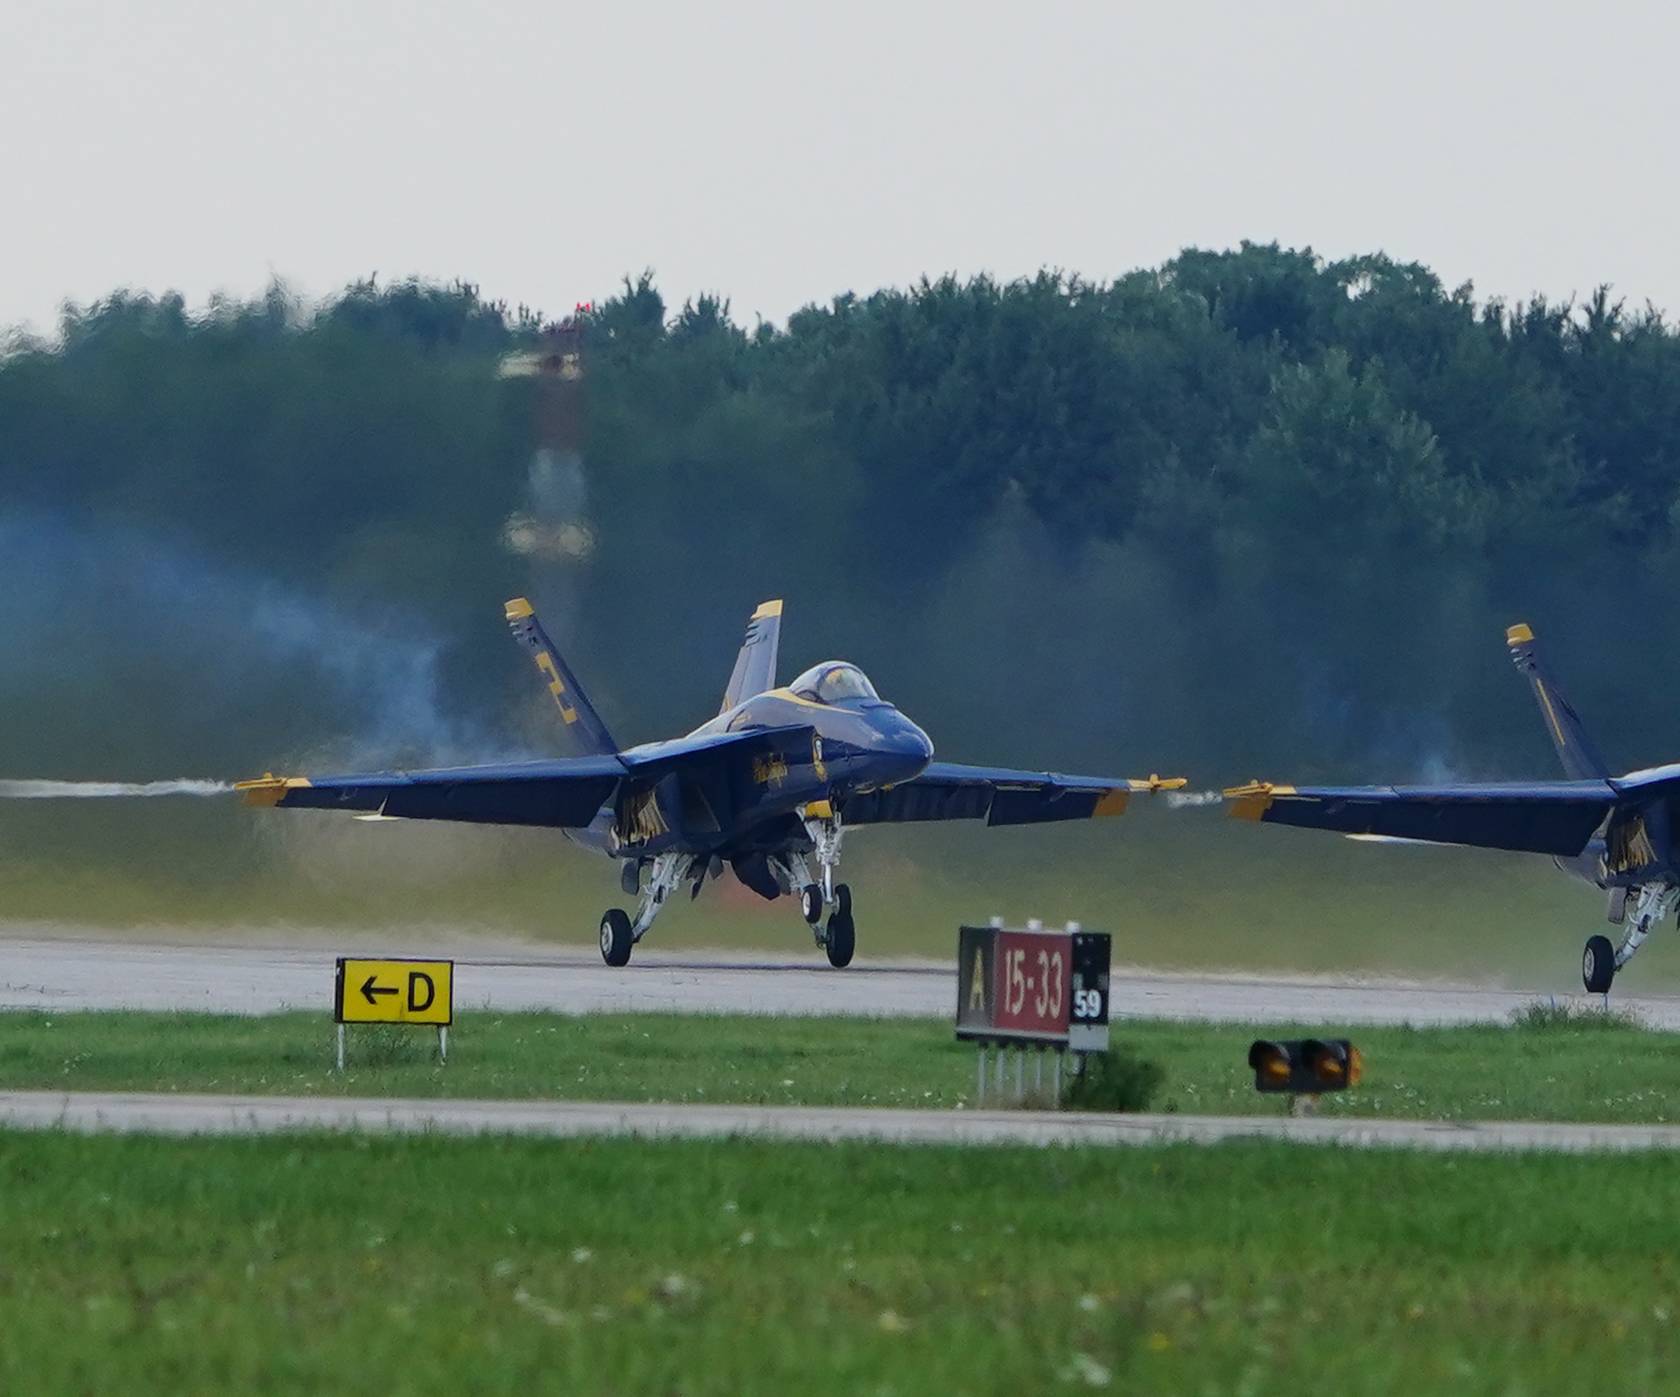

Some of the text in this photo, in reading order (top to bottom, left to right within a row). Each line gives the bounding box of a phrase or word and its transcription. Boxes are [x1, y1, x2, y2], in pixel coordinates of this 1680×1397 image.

[535, 651, 578, 724] 2
[407, 971, 435, 1012] D
[969, 946, 1063, 1019] A 15-33
[1073, 989, 1102, 1018] 59
